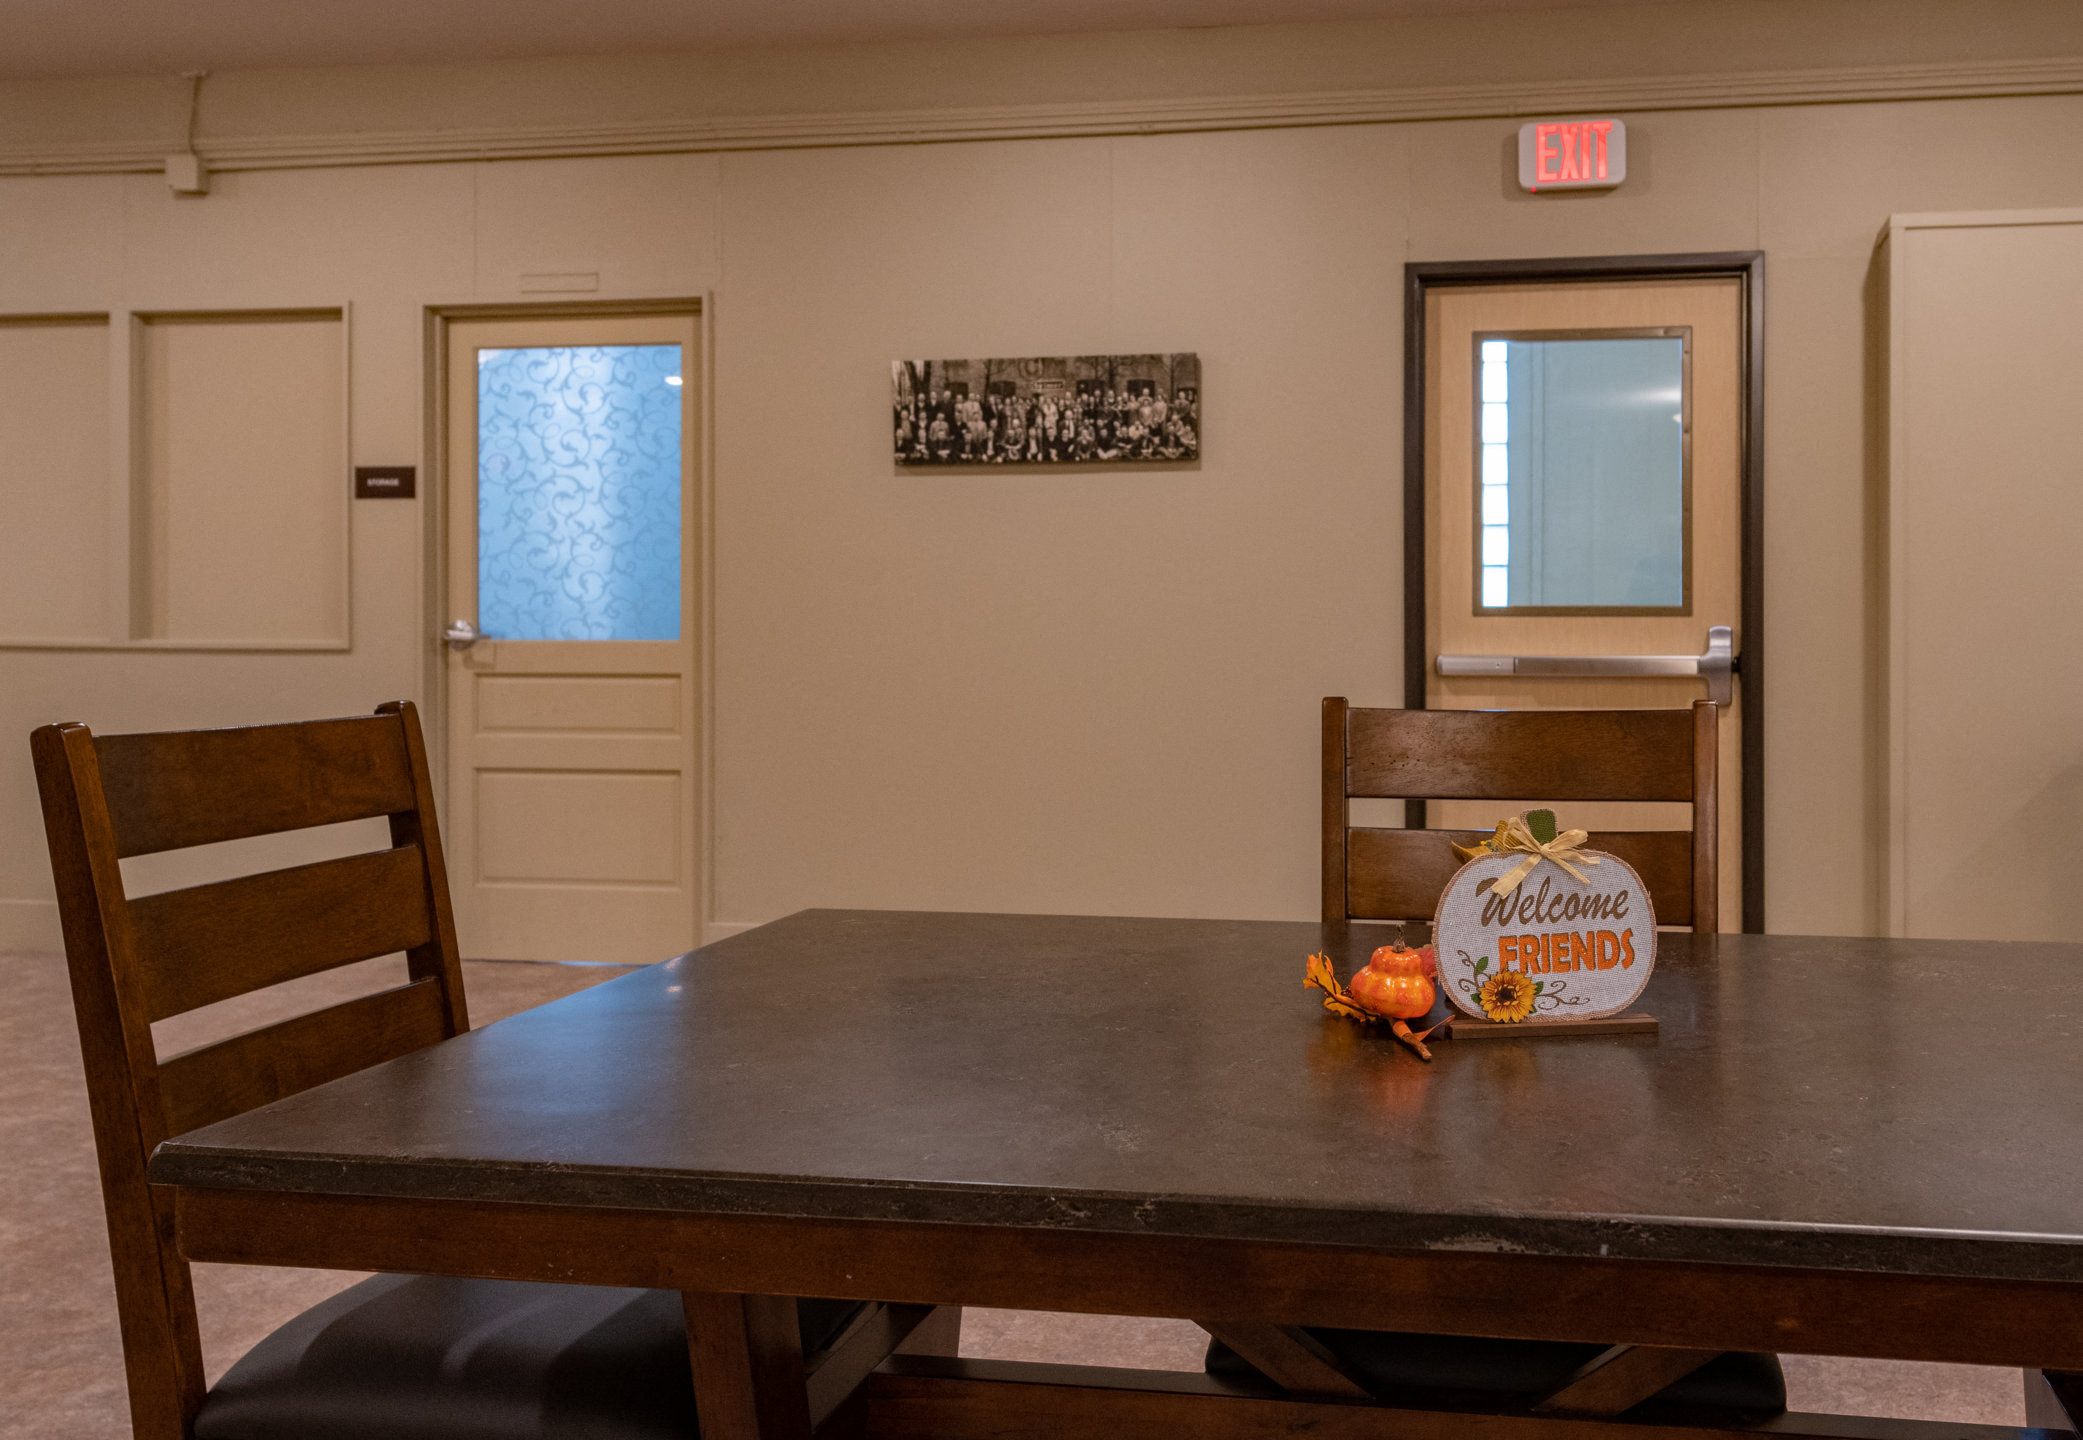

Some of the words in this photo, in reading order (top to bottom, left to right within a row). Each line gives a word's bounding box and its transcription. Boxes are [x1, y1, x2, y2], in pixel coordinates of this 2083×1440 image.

[1536, 121, 1613, 183] EXIT
[367, 478, 399, 487] STORAGE
[1476, 875, 1629, 927] Welcome
[1498, 928, 1635, 975] FRIENDS
